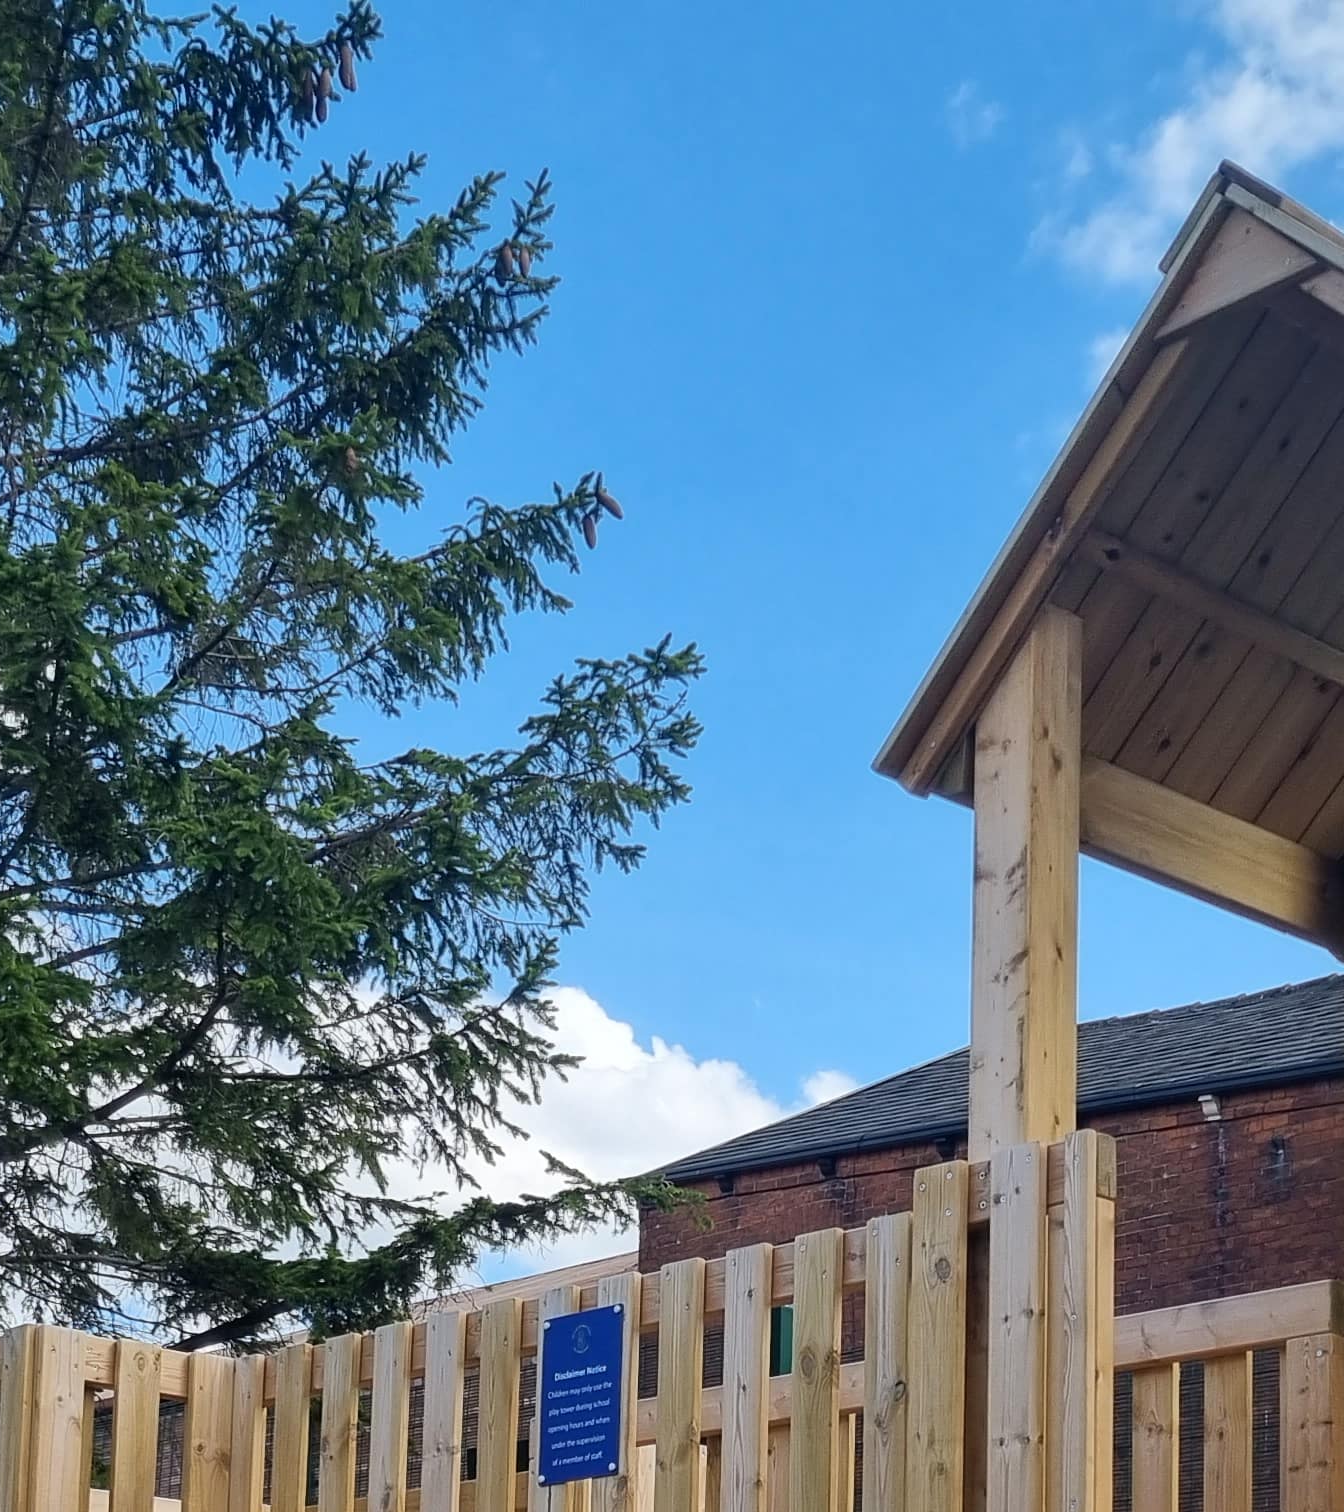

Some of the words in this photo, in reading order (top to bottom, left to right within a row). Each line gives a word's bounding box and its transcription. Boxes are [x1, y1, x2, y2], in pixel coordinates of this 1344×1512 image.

[554, 1370, 585, 1381] Disclaimer
[586, 1365, 607, 1375] Notice
[547, 1390, 568, 1399] Children
[569, 1388, 580, 1396] may
[548, 1408, 559, 1416] play
[560, 1406, 575, 1414] tower
[576, 1403, 592, 1411] during
[593, 1398, 610, 1407] school
[547, 1424, 568, 1434] opening
[569, 1421, 583, 1429] hours
[584, 1418, 594, 1427] and
[551, 1441, 565, 1450] under
[576, 1435, 605, 1445] supervision
[562, 1455, 583, 1464] member
[584, 1452, 590, 1461] of
